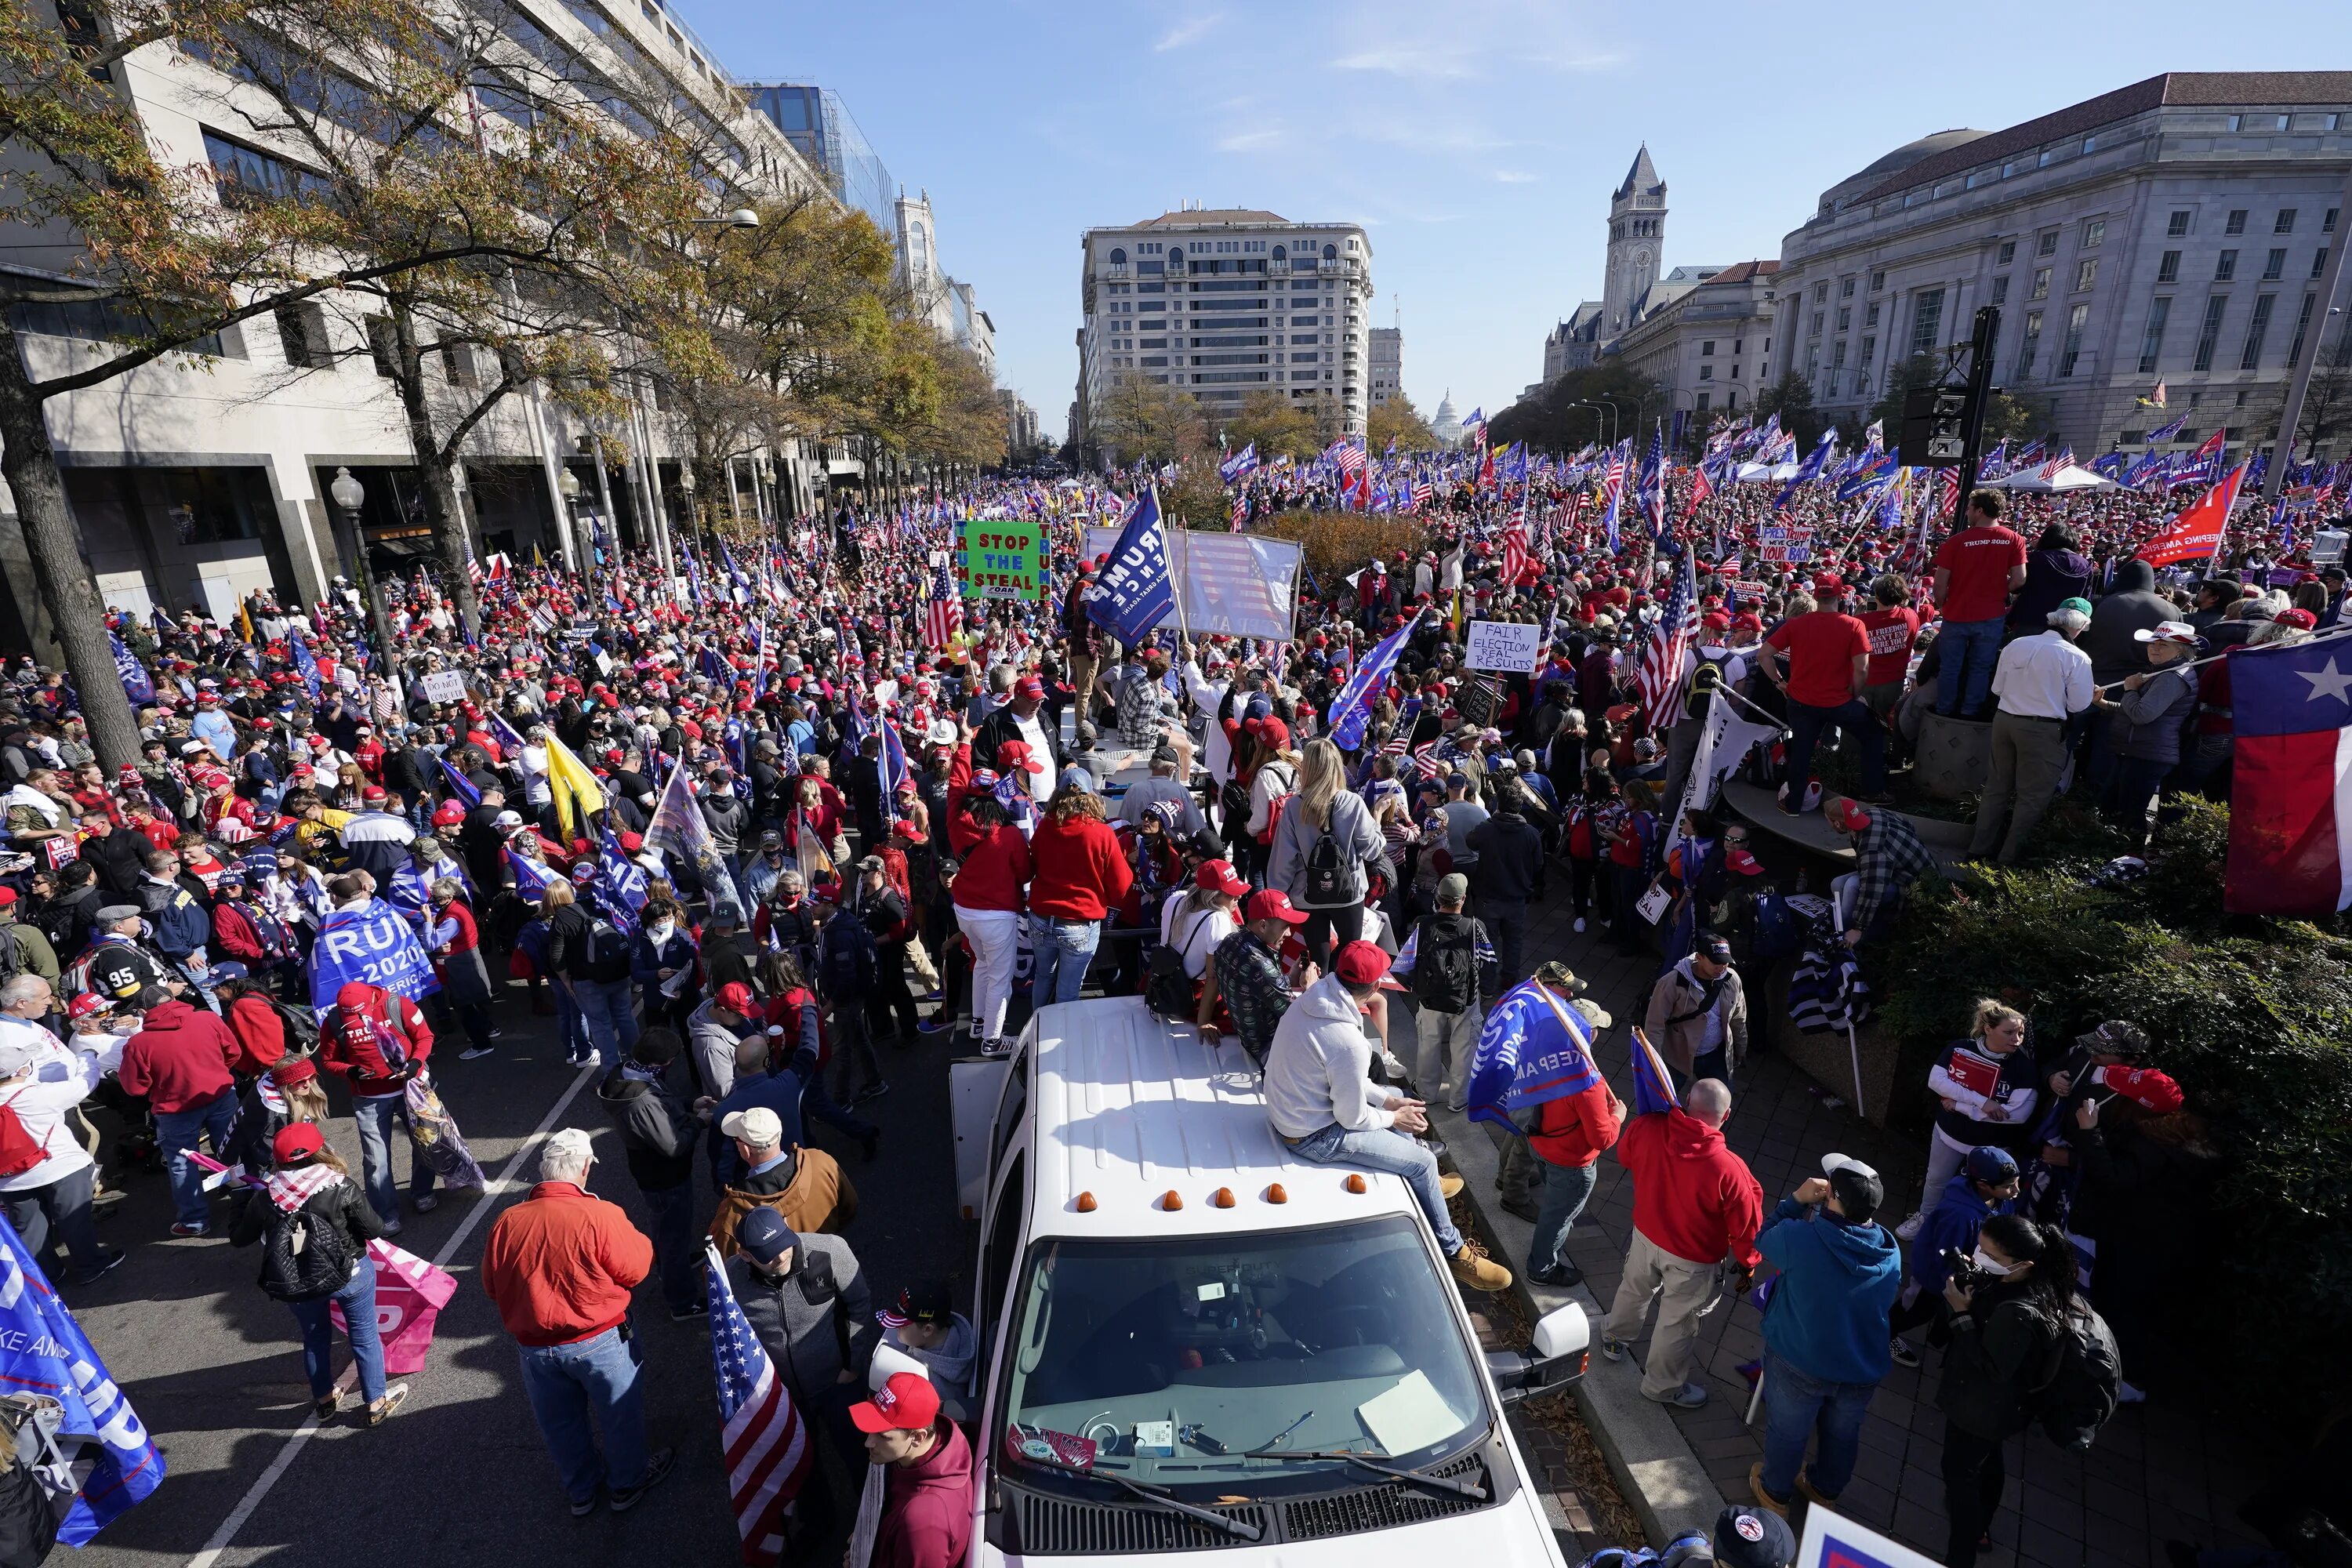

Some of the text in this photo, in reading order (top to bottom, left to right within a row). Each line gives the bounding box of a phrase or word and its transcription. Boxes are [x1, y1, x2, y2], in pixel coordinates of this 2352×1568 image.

[1763, 528, 1786, 539] PRES
[979, 533, 1029, 550] STOP
[1786, 539, 1804, 547] GOT
[956, 521, 969, 596] TRUMP
[1763, 546, 1809, 561] YOUR BACK
[985, 554, 1022, 570] THE
[1039, 524, 1051, 599] TRUMP
[975, 573, 1033, 590] STEAL
[1733, 583, 1763, 592] RUMP
[1486, 625, 1521, 640] FAIR
[1869, 630, 1907, 642] OESN'T END
[1875, 622, 1907, 635] FREEDOM
[1474, 638, 1530, 652] ELECTION
[1871, 641, 1889, 650] HERE
[1482, 648, 1512, 659] REAL
[1475, 655, 1532, 670] RESULTS
[427, 678, 459, 691] DO NOT
[1472, 701, 1488, 716] FAIR
[1475, 694, 1491, 709] PLAY
[1468, 708, 1484, 722] DNC
[1011, 757, 1022, 765] 45
[1003, 773, 1015, 797] TRUMP
[109, 966, 136, 988] 95
[347, 1019, 392, 1039] TRUP
[762, 1229, 777, 1240] adidas
[1058, 1434, 1091, 1467] TOBAGO
